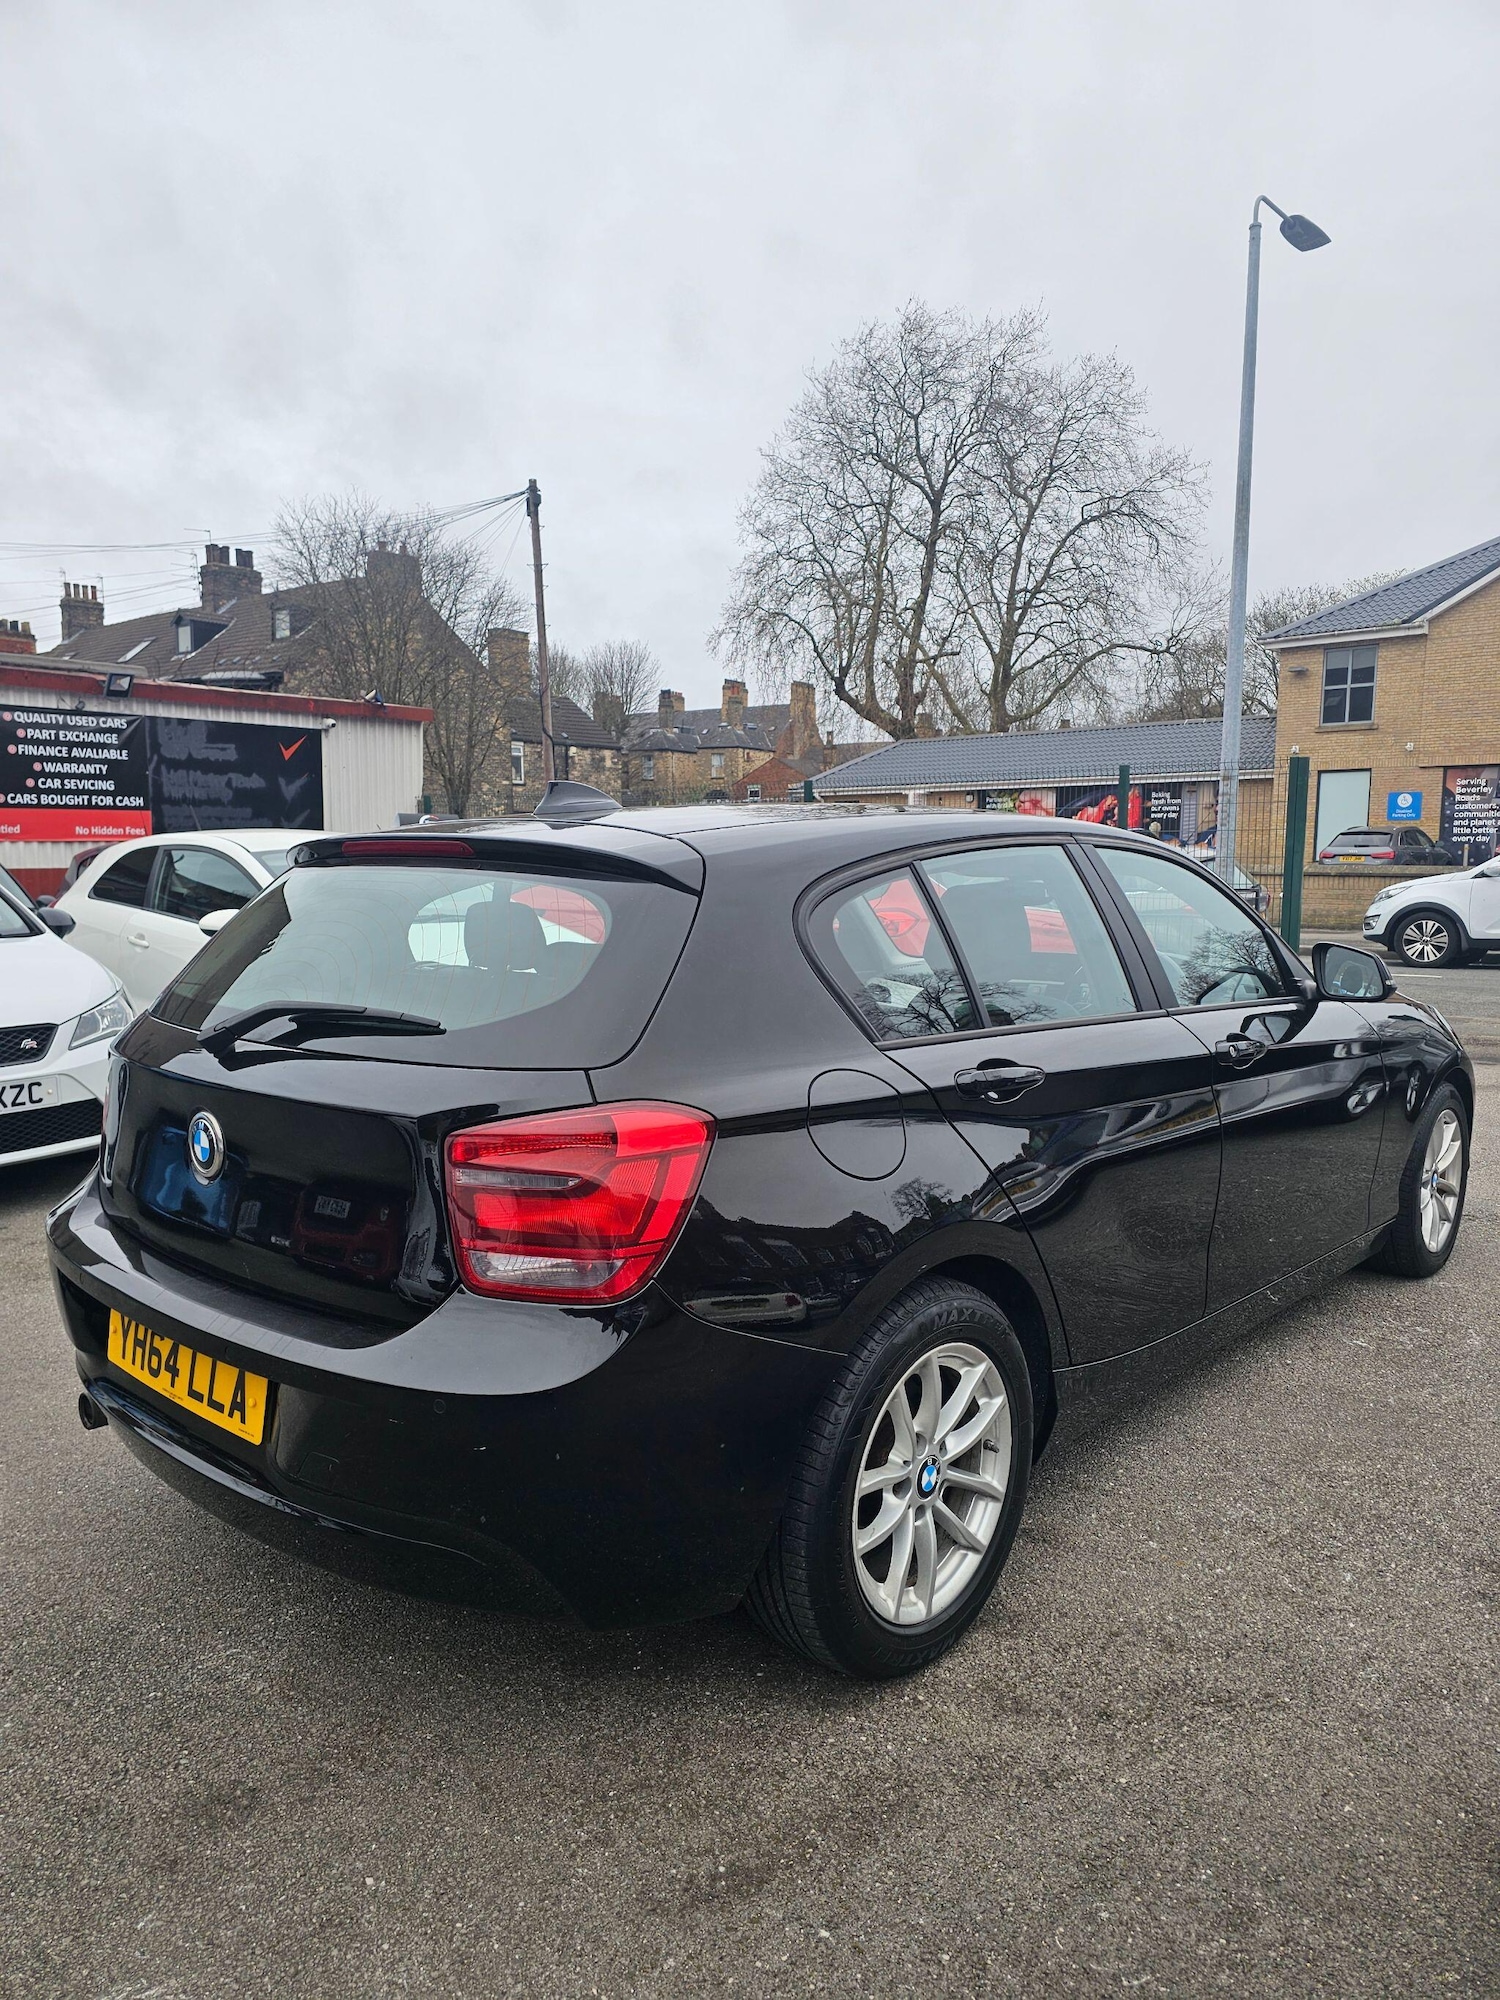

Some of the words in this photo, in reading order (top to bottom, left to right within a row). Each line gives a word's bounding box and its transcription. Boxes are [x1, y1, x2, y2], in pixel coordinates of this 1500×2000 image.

[13, 711, 64, 724] QUALITY
[67, 715, 97, 727] USED
[100, 717, 128, 729] CARS
[26, 728, 56, 740] PART
[59, 731, 119, 744] EXCHANGE
[18, 744, 69, 757] FINANCE
[71, 747, 129, 760] AVALIABLE
[42, 761, 108, 775] WARRANTY
[37, 777, 62, 789] CAR
[64, 779, 115, 791] SEVICING
[1456, 778, 1487, 786] Serving
[1455, 786, 1493, 794] Beverley
[7, 793, 38, 804] CARS
[40, 794, 89, 806] BOUGHT
[92, 795, 114, 806] FOR
[115, 796, 144, 807] CASH
[1470, 819, 1496, 827] planet
[75, 826, 89, 835] No
[91, 826, 124, 835] Hidden
[125, 826, 146, 836] Fees
[1452, 835, 1475, 843] every
[1475, 835, 1490, 843] day
[120, 1313, 180, 1389] YH64
[187, 1349, 246, 1426] LLA
